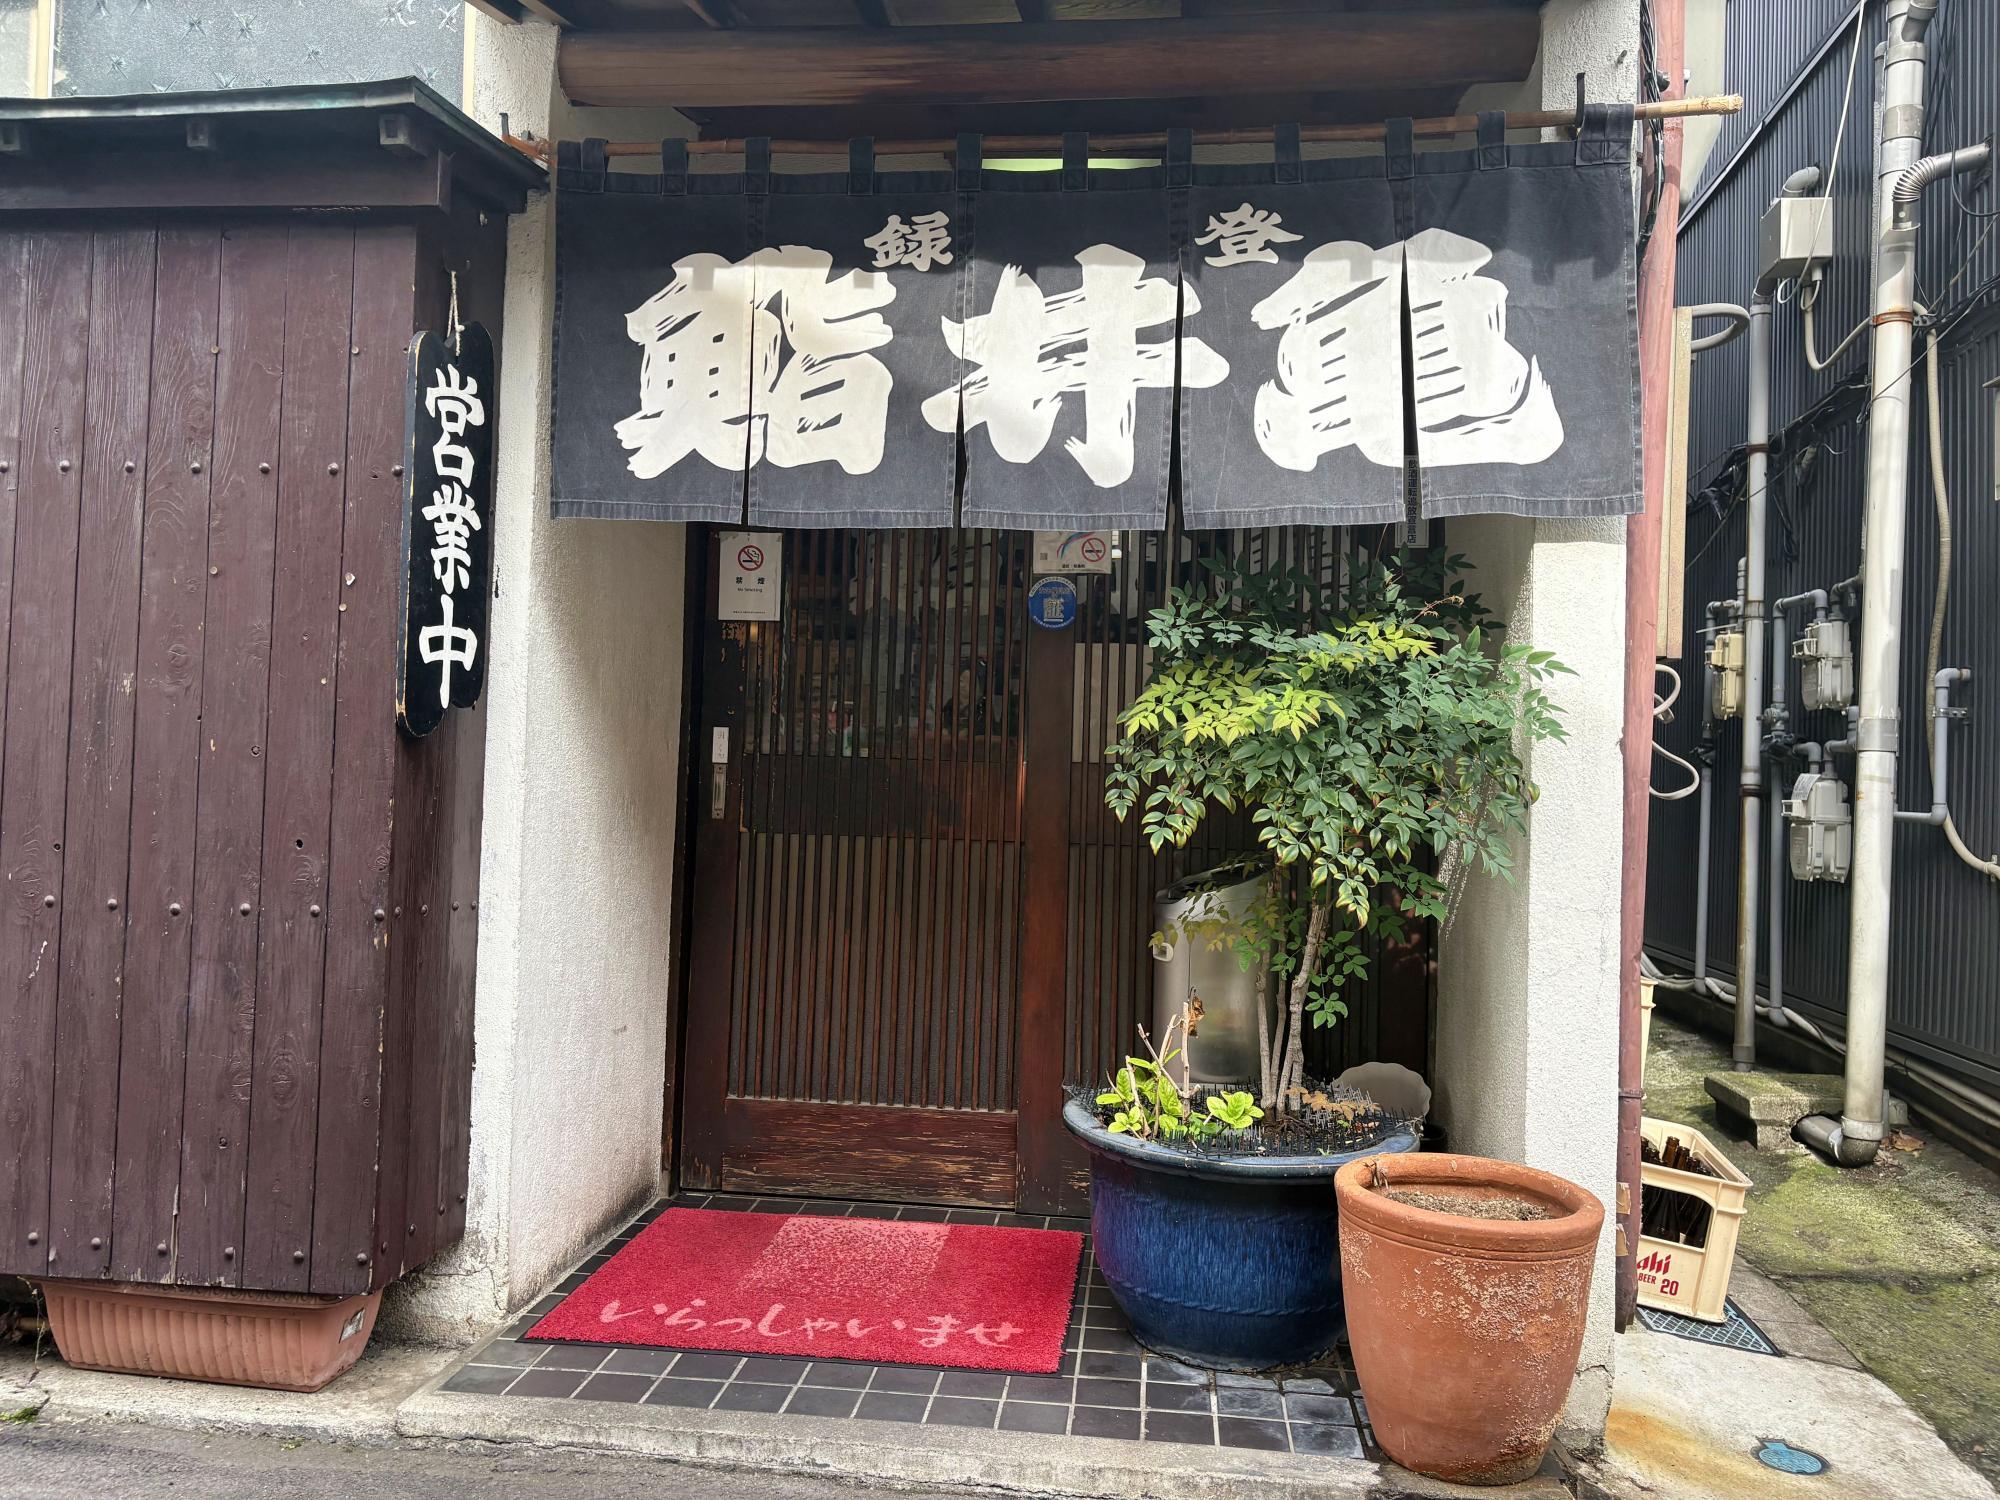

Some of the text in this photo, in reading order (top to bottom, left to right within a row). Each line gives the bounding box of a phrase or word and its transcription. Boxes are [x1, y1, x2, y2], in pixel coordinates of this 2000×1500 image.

[417, 363, 485, 709] 営業中
[1636, 1250, 1672, 1275] ahi
[1638, 1272, 1679, 1296] BEER 20
[600, 1299, 1024, 1348] いらっしゃいませ
